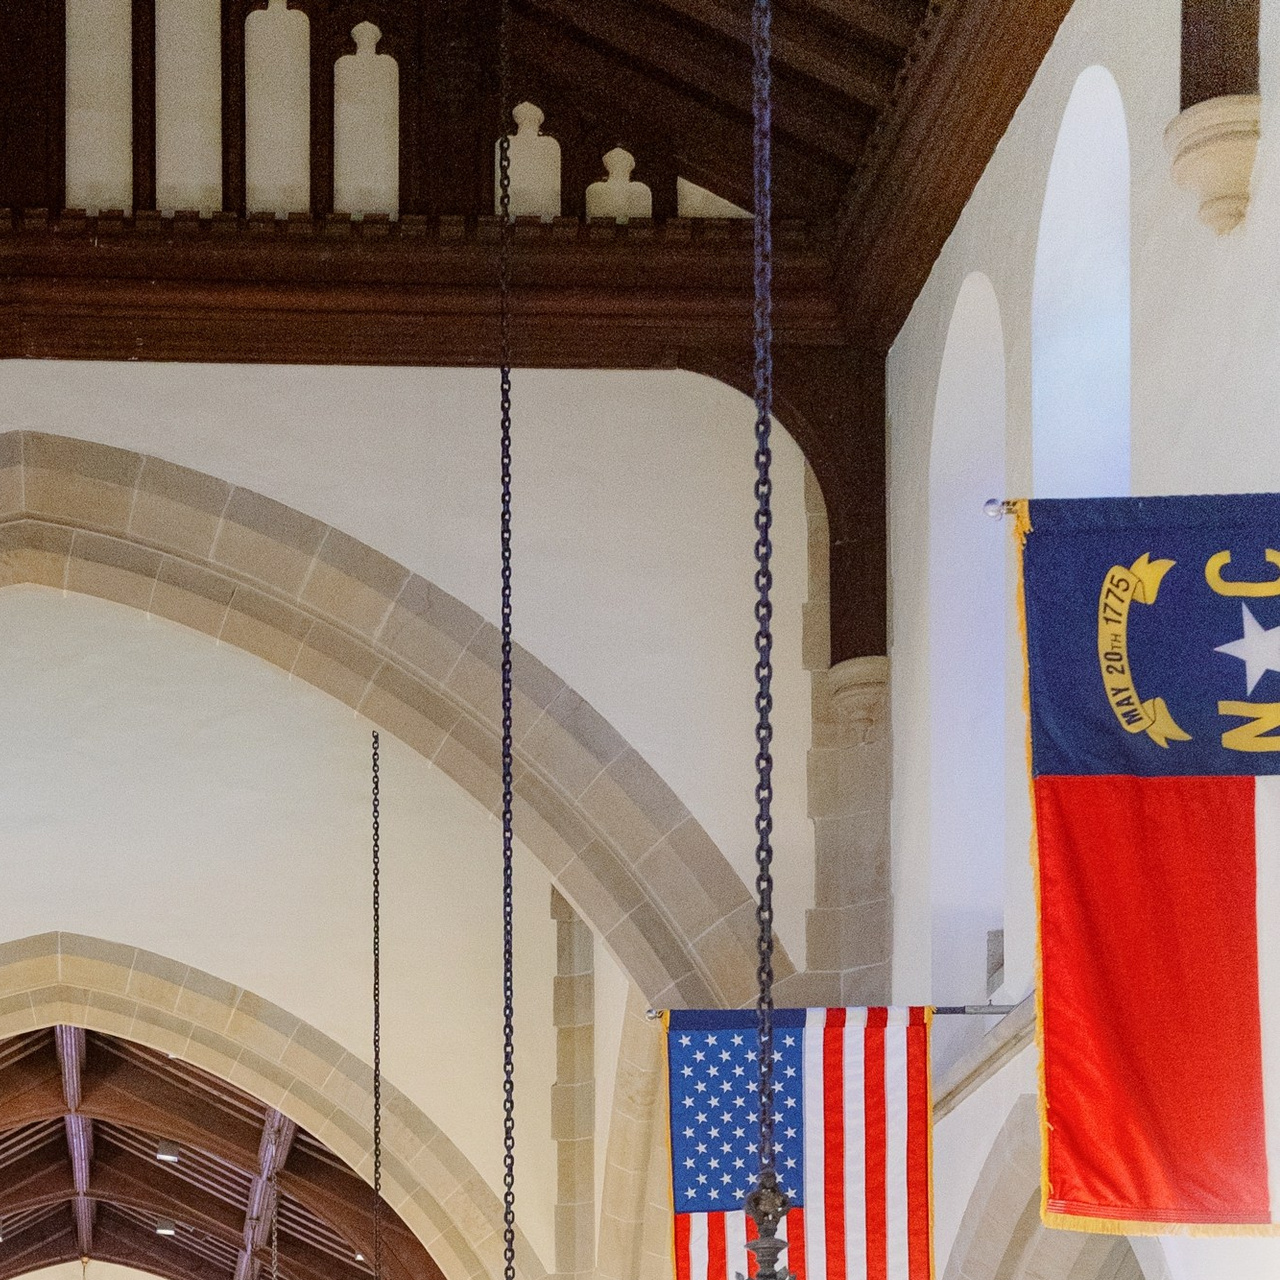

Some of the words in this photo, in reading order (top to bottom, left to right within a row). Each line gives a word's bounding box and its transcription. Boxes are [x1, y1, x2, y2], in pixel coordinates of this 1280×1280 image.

[1205, 548, 1280, 597] C
[1103, 574, 1130, 626] 1775
[1104, 633, 1125, 675] 20TH
[1111, 687, 1144, 726] MAY
[1218, 700, 1280, 752] N
